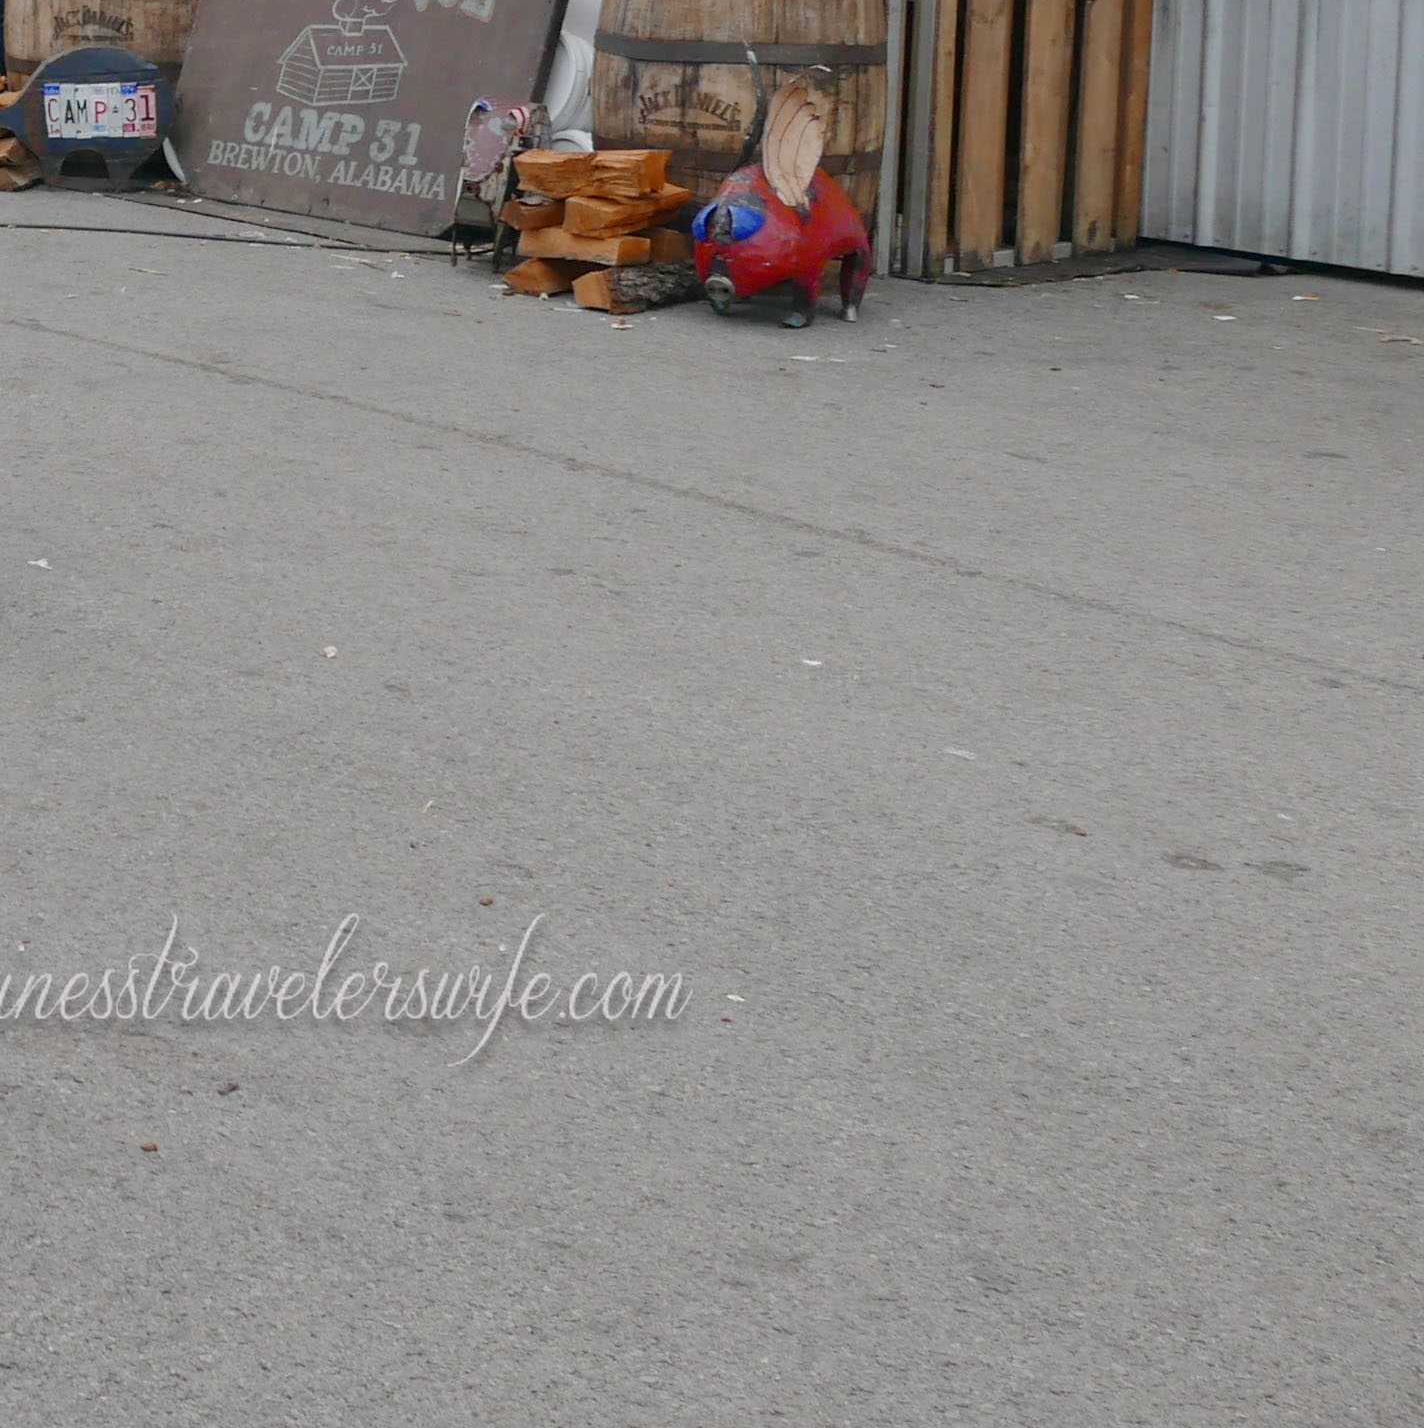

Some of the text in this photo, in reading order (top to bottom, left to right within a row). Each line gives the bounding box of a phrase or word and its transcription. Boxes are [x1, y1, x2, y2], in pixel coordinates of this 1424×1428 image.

[326, 42, 384, 56] CAMP 31
[243, 102, 422, 167] CAMP 31
[207, 139, 446, 200] BREWTON, ALABAMA
